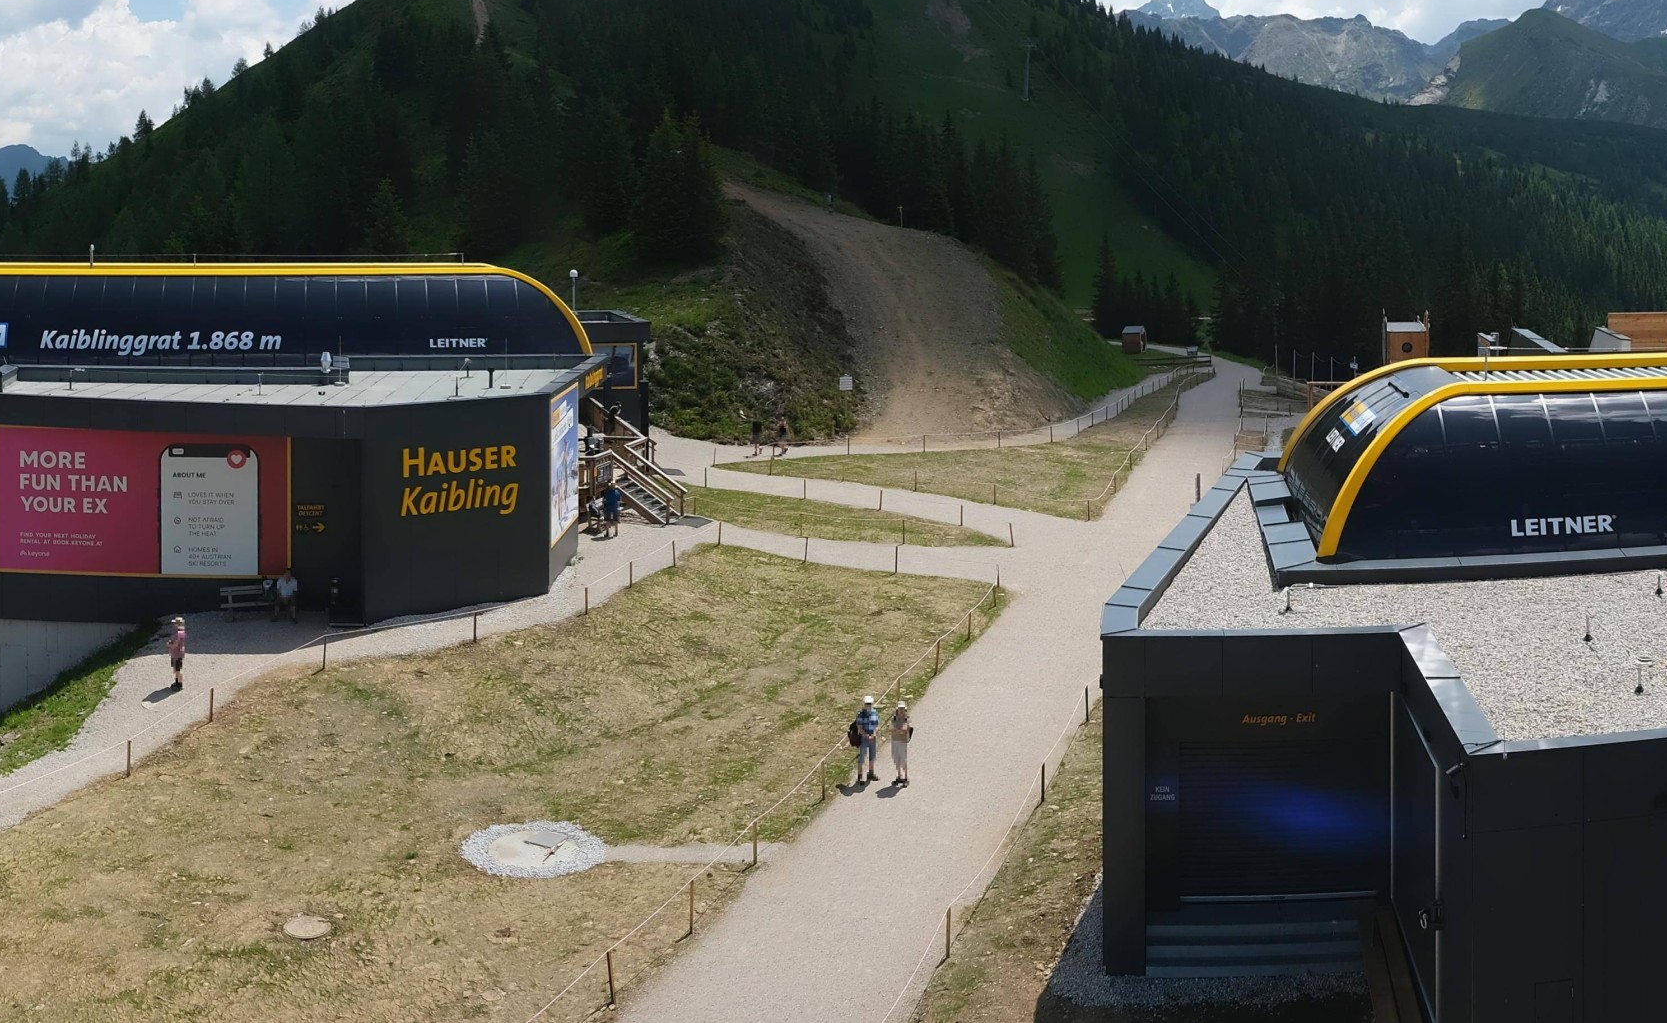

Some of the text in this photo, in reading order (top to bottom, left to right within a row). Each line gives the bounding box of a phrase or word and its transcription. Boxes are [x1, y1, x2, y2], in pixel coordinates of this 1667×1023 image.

[39, 329, 281, 356] Kaiblinggrat 1.868 m
[429, 338, 487, 348] LEITNER
[19, 450, 86, 469] MORE
[402, 445, 517, 478] HAUSER
[19, 473, 127, 492] FUN THAN
[20, 496, 108, 514] YOUR EX
[400, 479, 519, 517] Kaibling
[1510, 514, 1614, 537] LEITNER
[1241, 714, 1287, 726] Ausgang
[1296, 712, 1316, 723] Exit
[1155, 785, 1170, 793] KEIN
